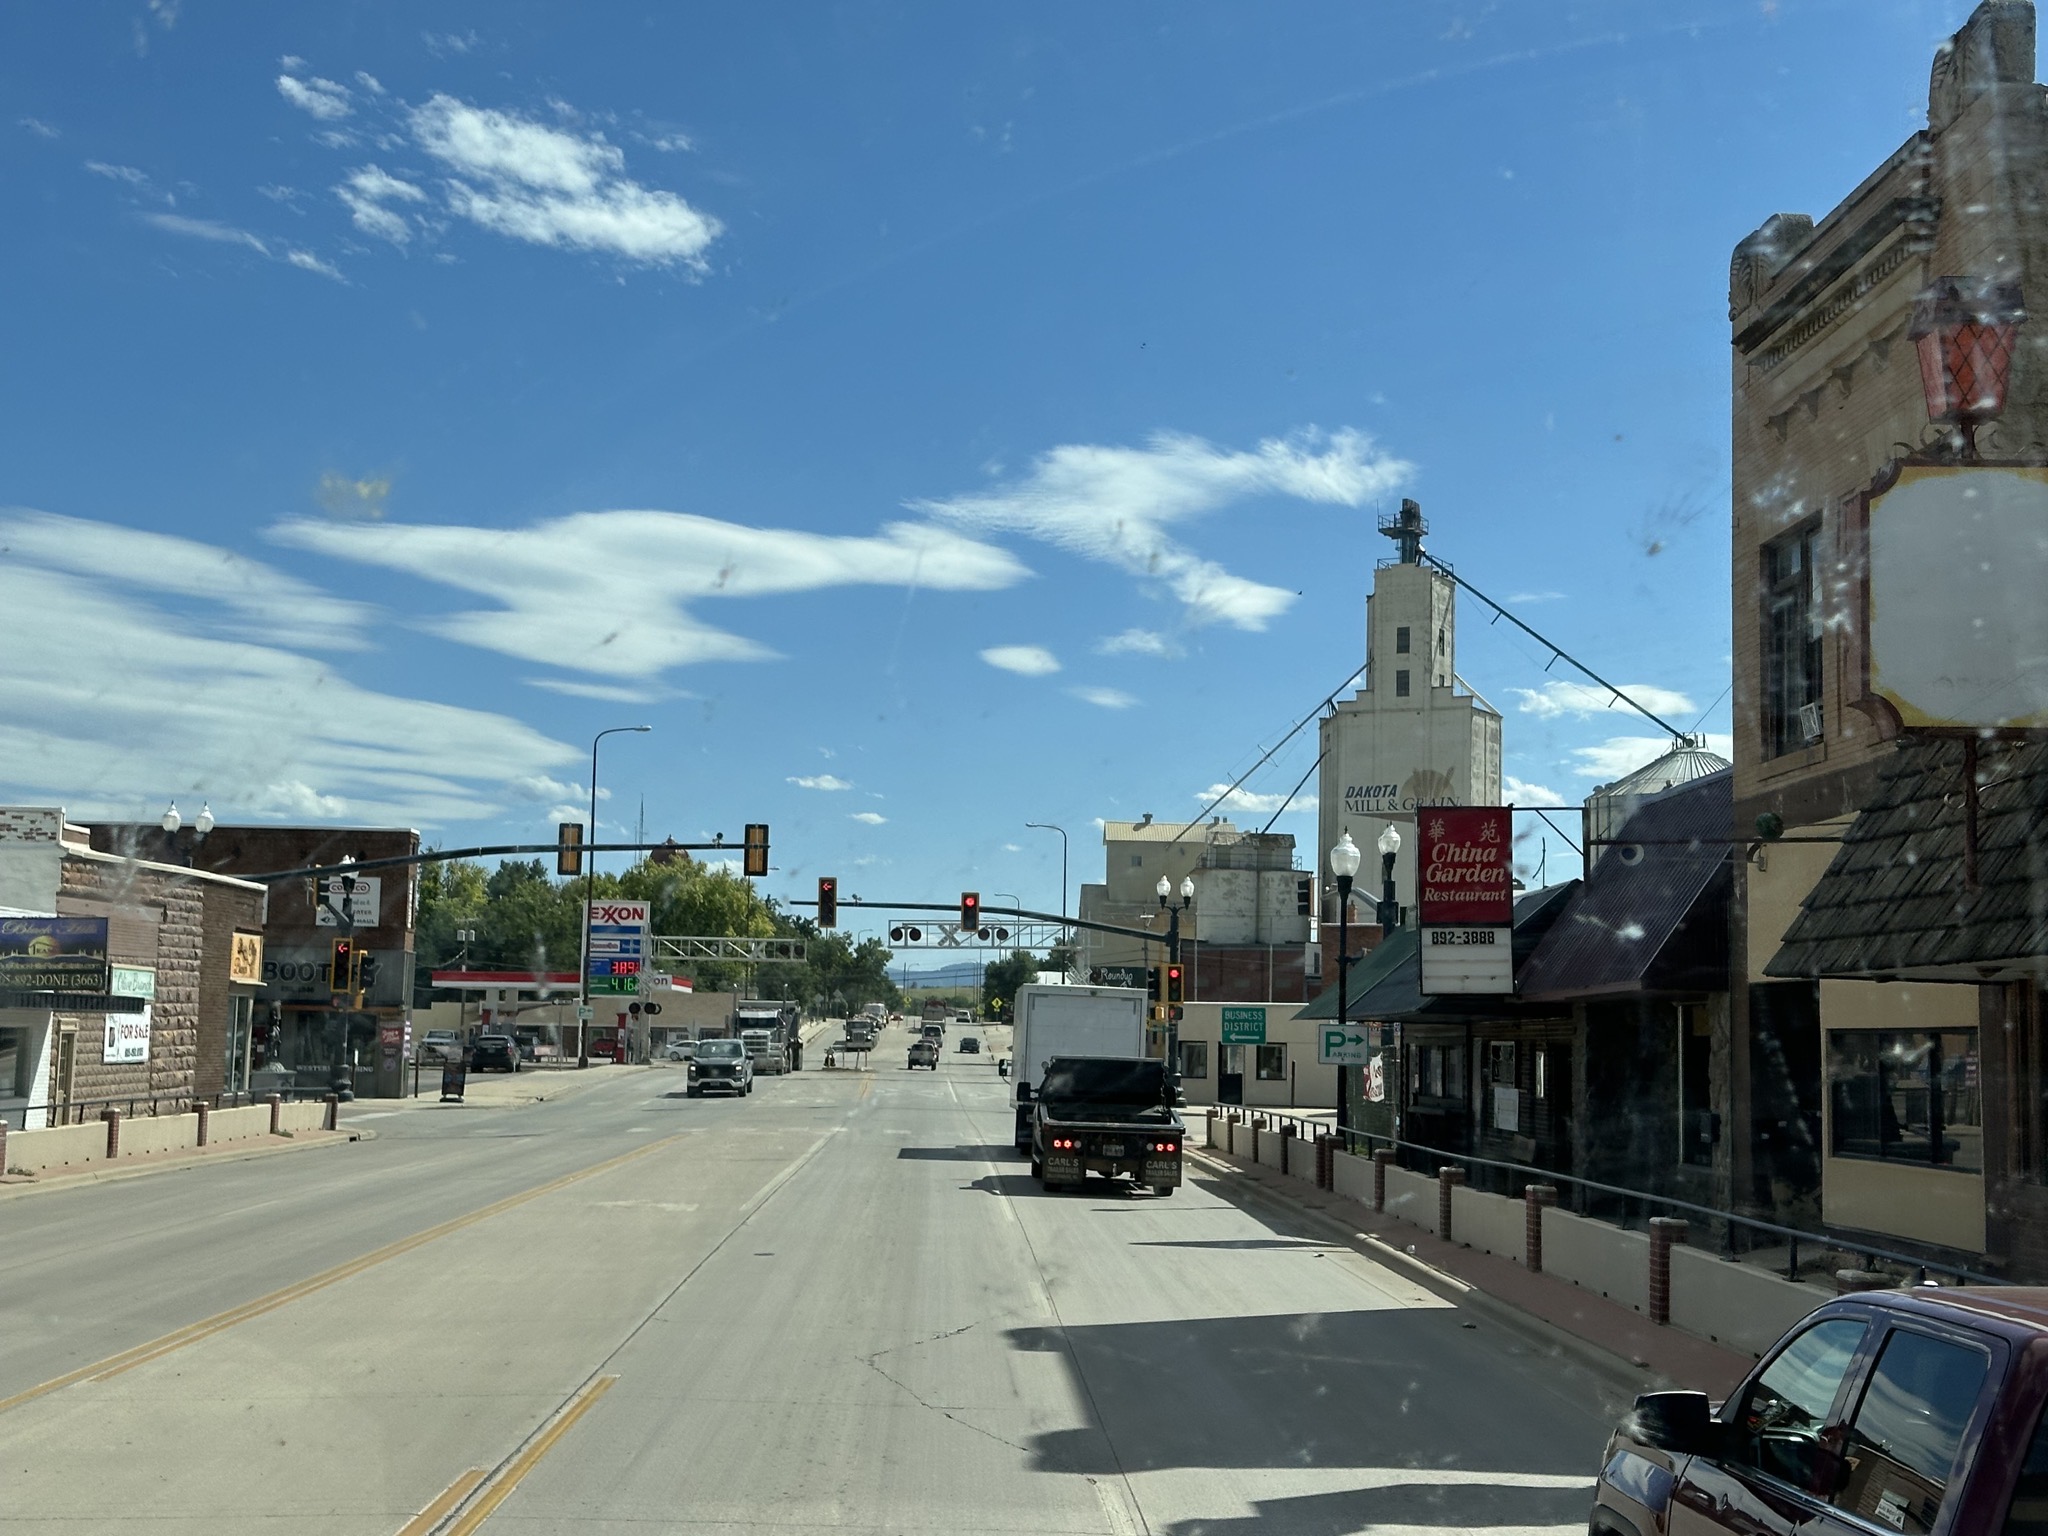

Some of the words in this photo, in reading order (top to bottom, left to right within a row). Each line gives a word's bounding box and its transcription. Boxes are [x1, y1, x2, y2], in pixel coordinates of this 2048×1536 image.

[1344, 784, 1398, 799] DAKOTA
[1344, 799, 1385, 813] MILL
[1387, 799, 1399, 812] &
[1431, 841, 1498, 863] China
[1426, 863, 1506, 884] Garden
[331, 884, 367, 892] COCO
[1424, 887, 1506, 903] Restaurant
[591, 905, 645, 925] EXXON
[1431, 931, 1496, 945] 892-3888
[263, 960, 384, 985] BOOTRY
[1101, 967, 1133, 986] Roundup
[1225, 1010, 1263, 1021] BUSINESS
[121, 1024, 134, 1040] FOR
[134, 1024, 149, 1039] SALE
[1224, 1022, 1264, 1032] DISTRICT
[1047, 1157, 1079, 1167] CARL'S
[1146, 1160, 1178, 1170] CARL'S
